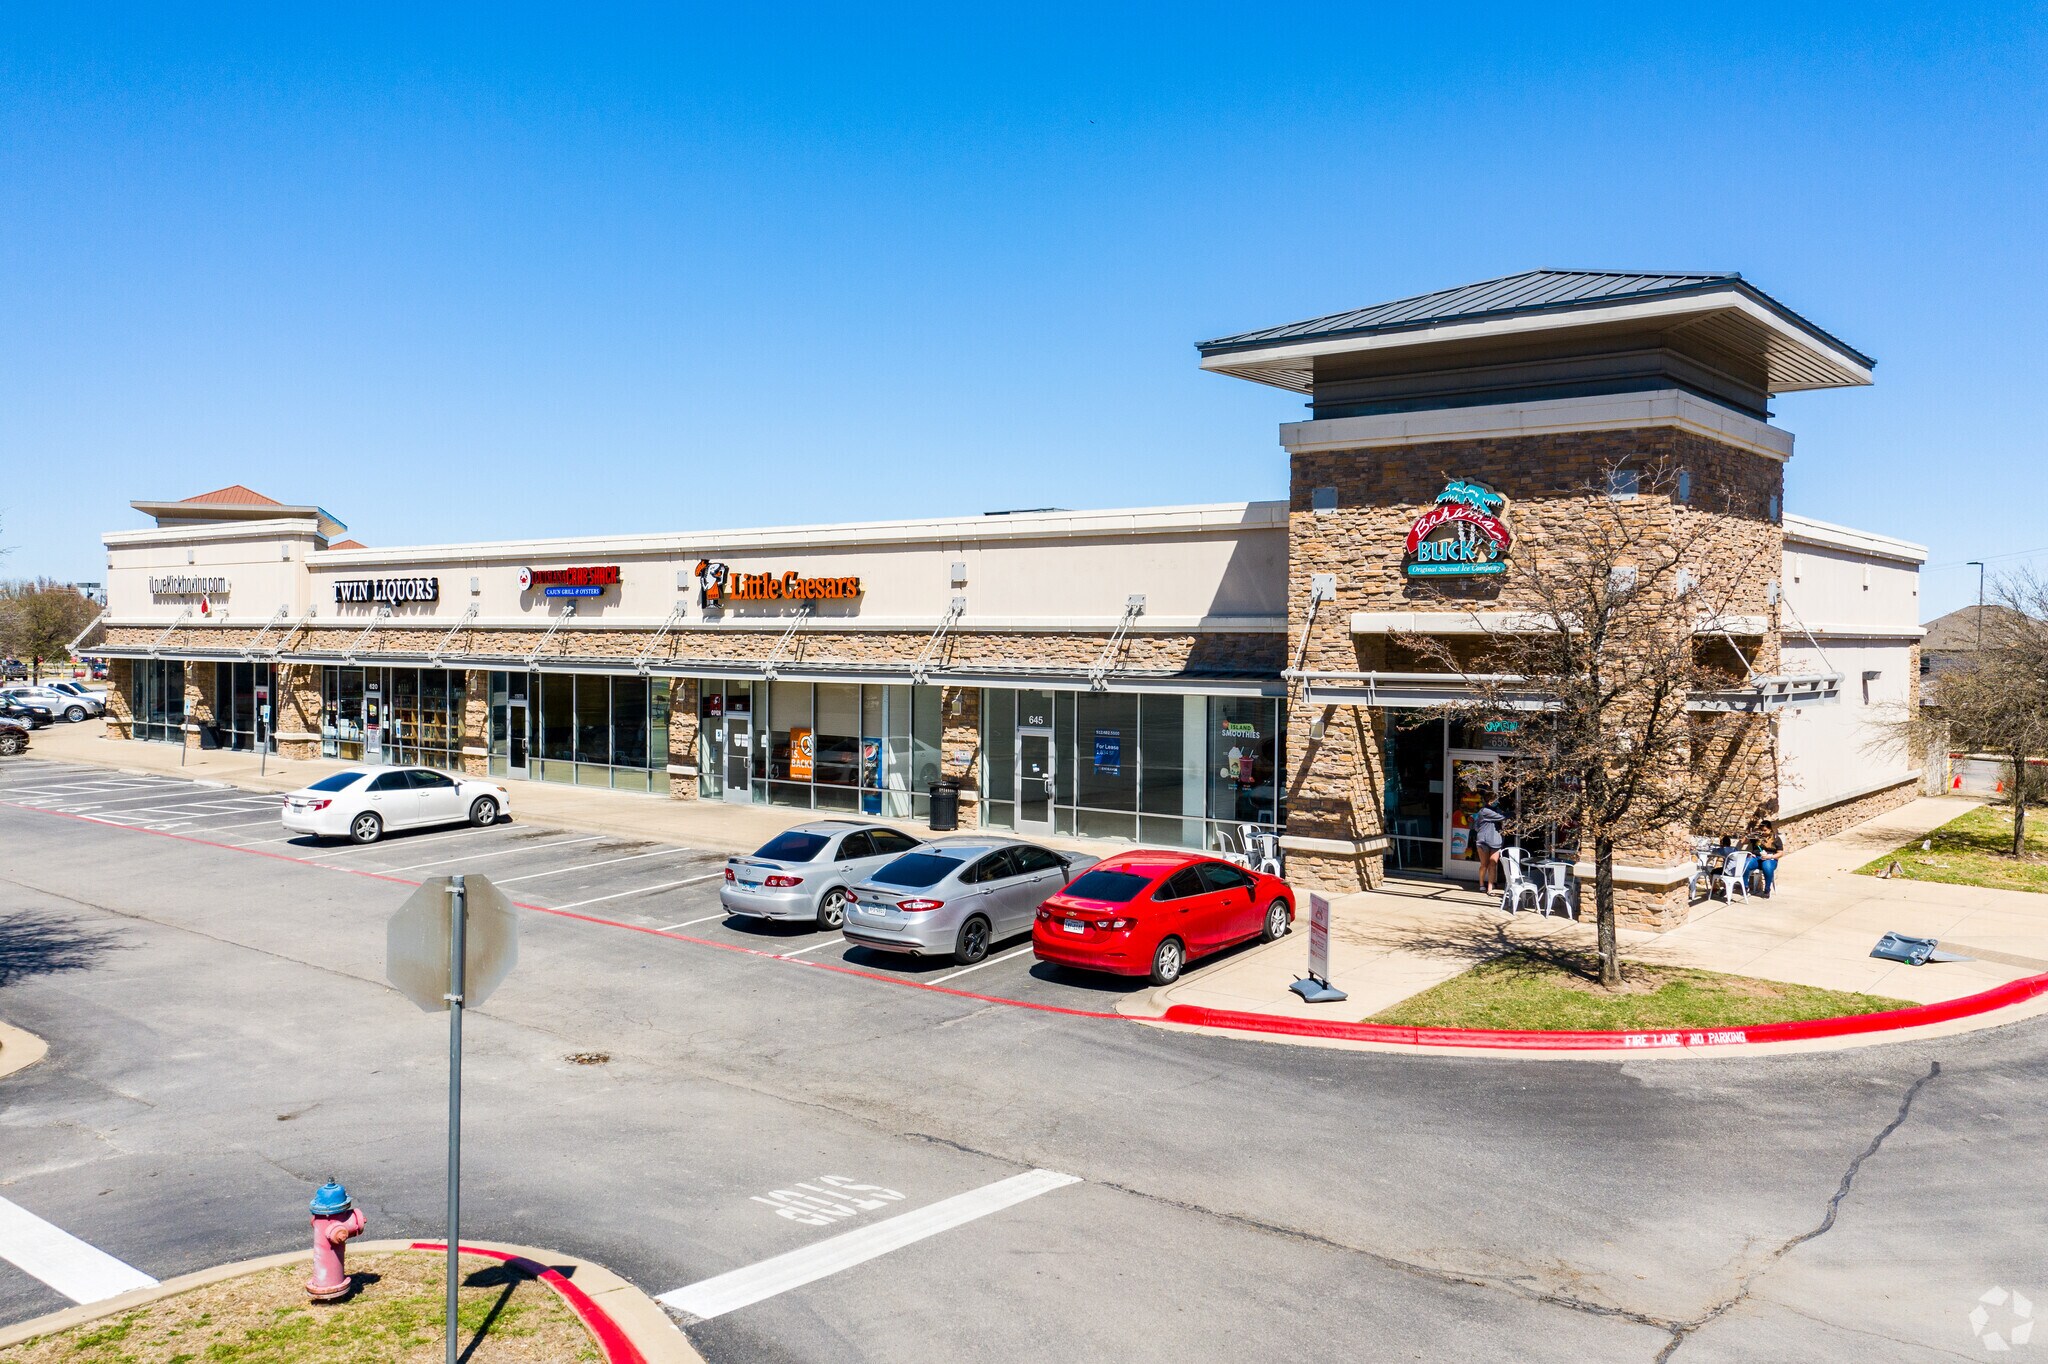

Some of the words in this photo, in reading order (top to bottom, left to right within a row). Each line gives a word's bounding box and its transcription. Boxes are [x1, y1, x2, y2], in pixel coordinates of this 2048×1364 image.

[567, 567, 590, 585] CRAB
[590, 566, 617, 584] SHACK
[1412, 566, 1437, 575] Original
[1438, 565, 1460, 573] Shaved
[1461, 562, 1471, 572] Ice
[332, 581, 368, 601] TWIN
[373, 579, 435, 605] LIQUORS
[729, 572, 781, 600] Little
[782, 571, 861, 599] Caesars
[1028, 715, 1044, 725] 645
[1485, 720, 1519, 732] OPEN
[1221, 729, 1260, 739] SMOOTHIES
[791, 759, 812, 769] BACK!
[1625, 1035, 1649, 1046] FIRE
[1653, 1033, 1681, 1046] LANE
[1689, 1033, 1704, 1044] NO
[1707, 1031, 1746, 1044] PARKING
[749, 1175, 906, 1225] STOP
